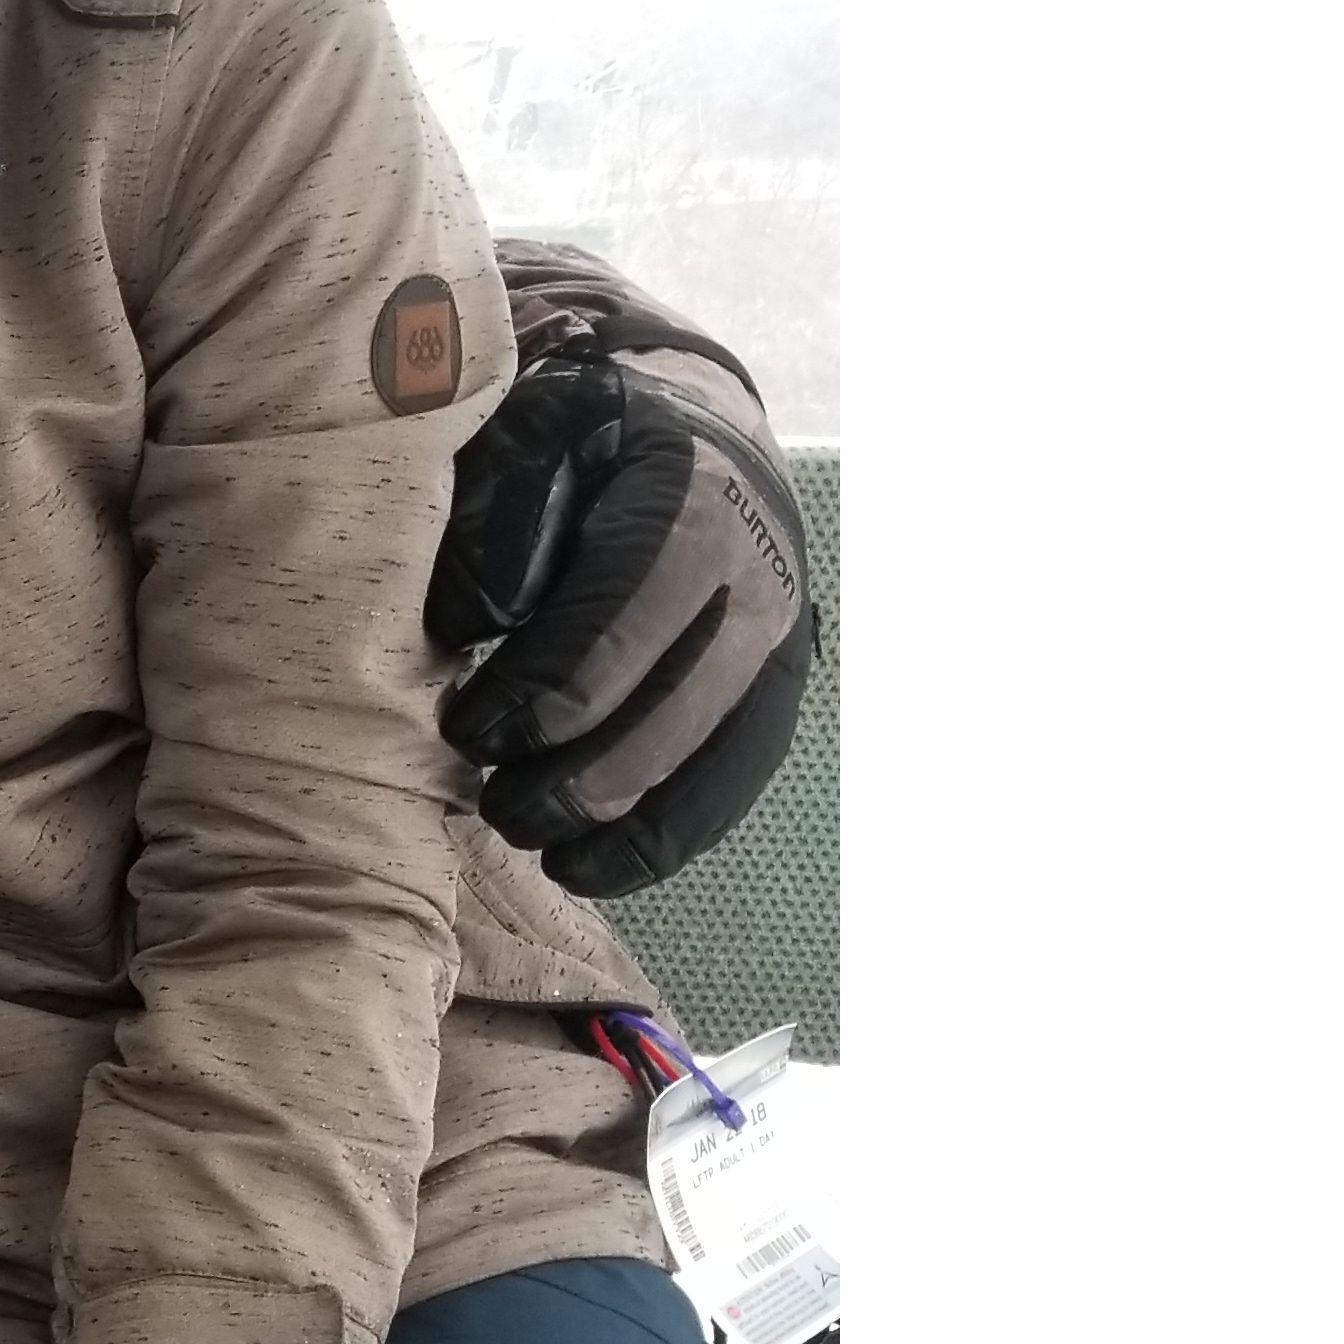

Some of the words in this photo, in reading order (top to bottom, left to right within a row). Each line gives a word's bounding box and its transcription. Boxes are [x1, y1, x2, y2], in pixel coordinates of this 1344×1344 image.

[723, 476, 796, 602] BURTON
[690, 1133, 717, 1164] JAN
[750, 1102, 768, 1127] 18
